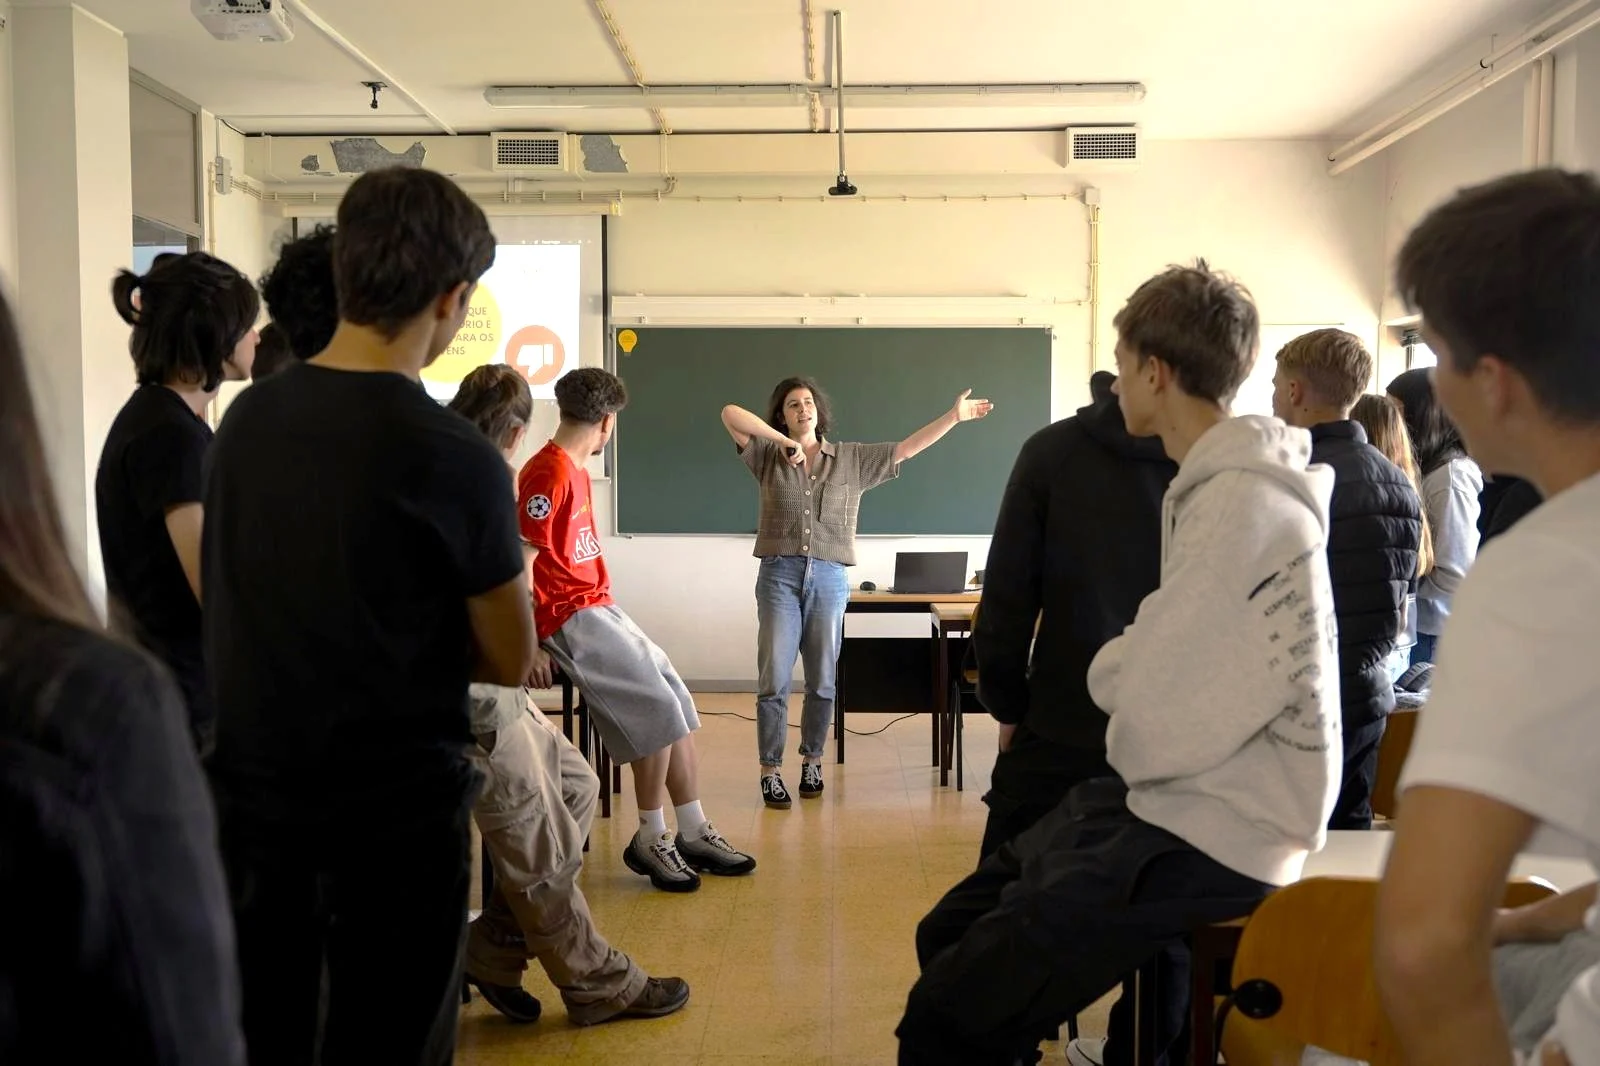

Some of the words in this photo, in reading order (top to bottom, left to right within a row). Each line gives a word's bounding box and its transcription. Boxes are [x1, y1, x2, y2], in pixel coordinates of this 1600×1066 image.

[468, 307, 487, 317] QUE
[455, 333, 477, 341] ARA
[480, 333, 494, 341] OS
[446, 346, 465, 355] ENS
[574, 530, 601, 560] AIG
